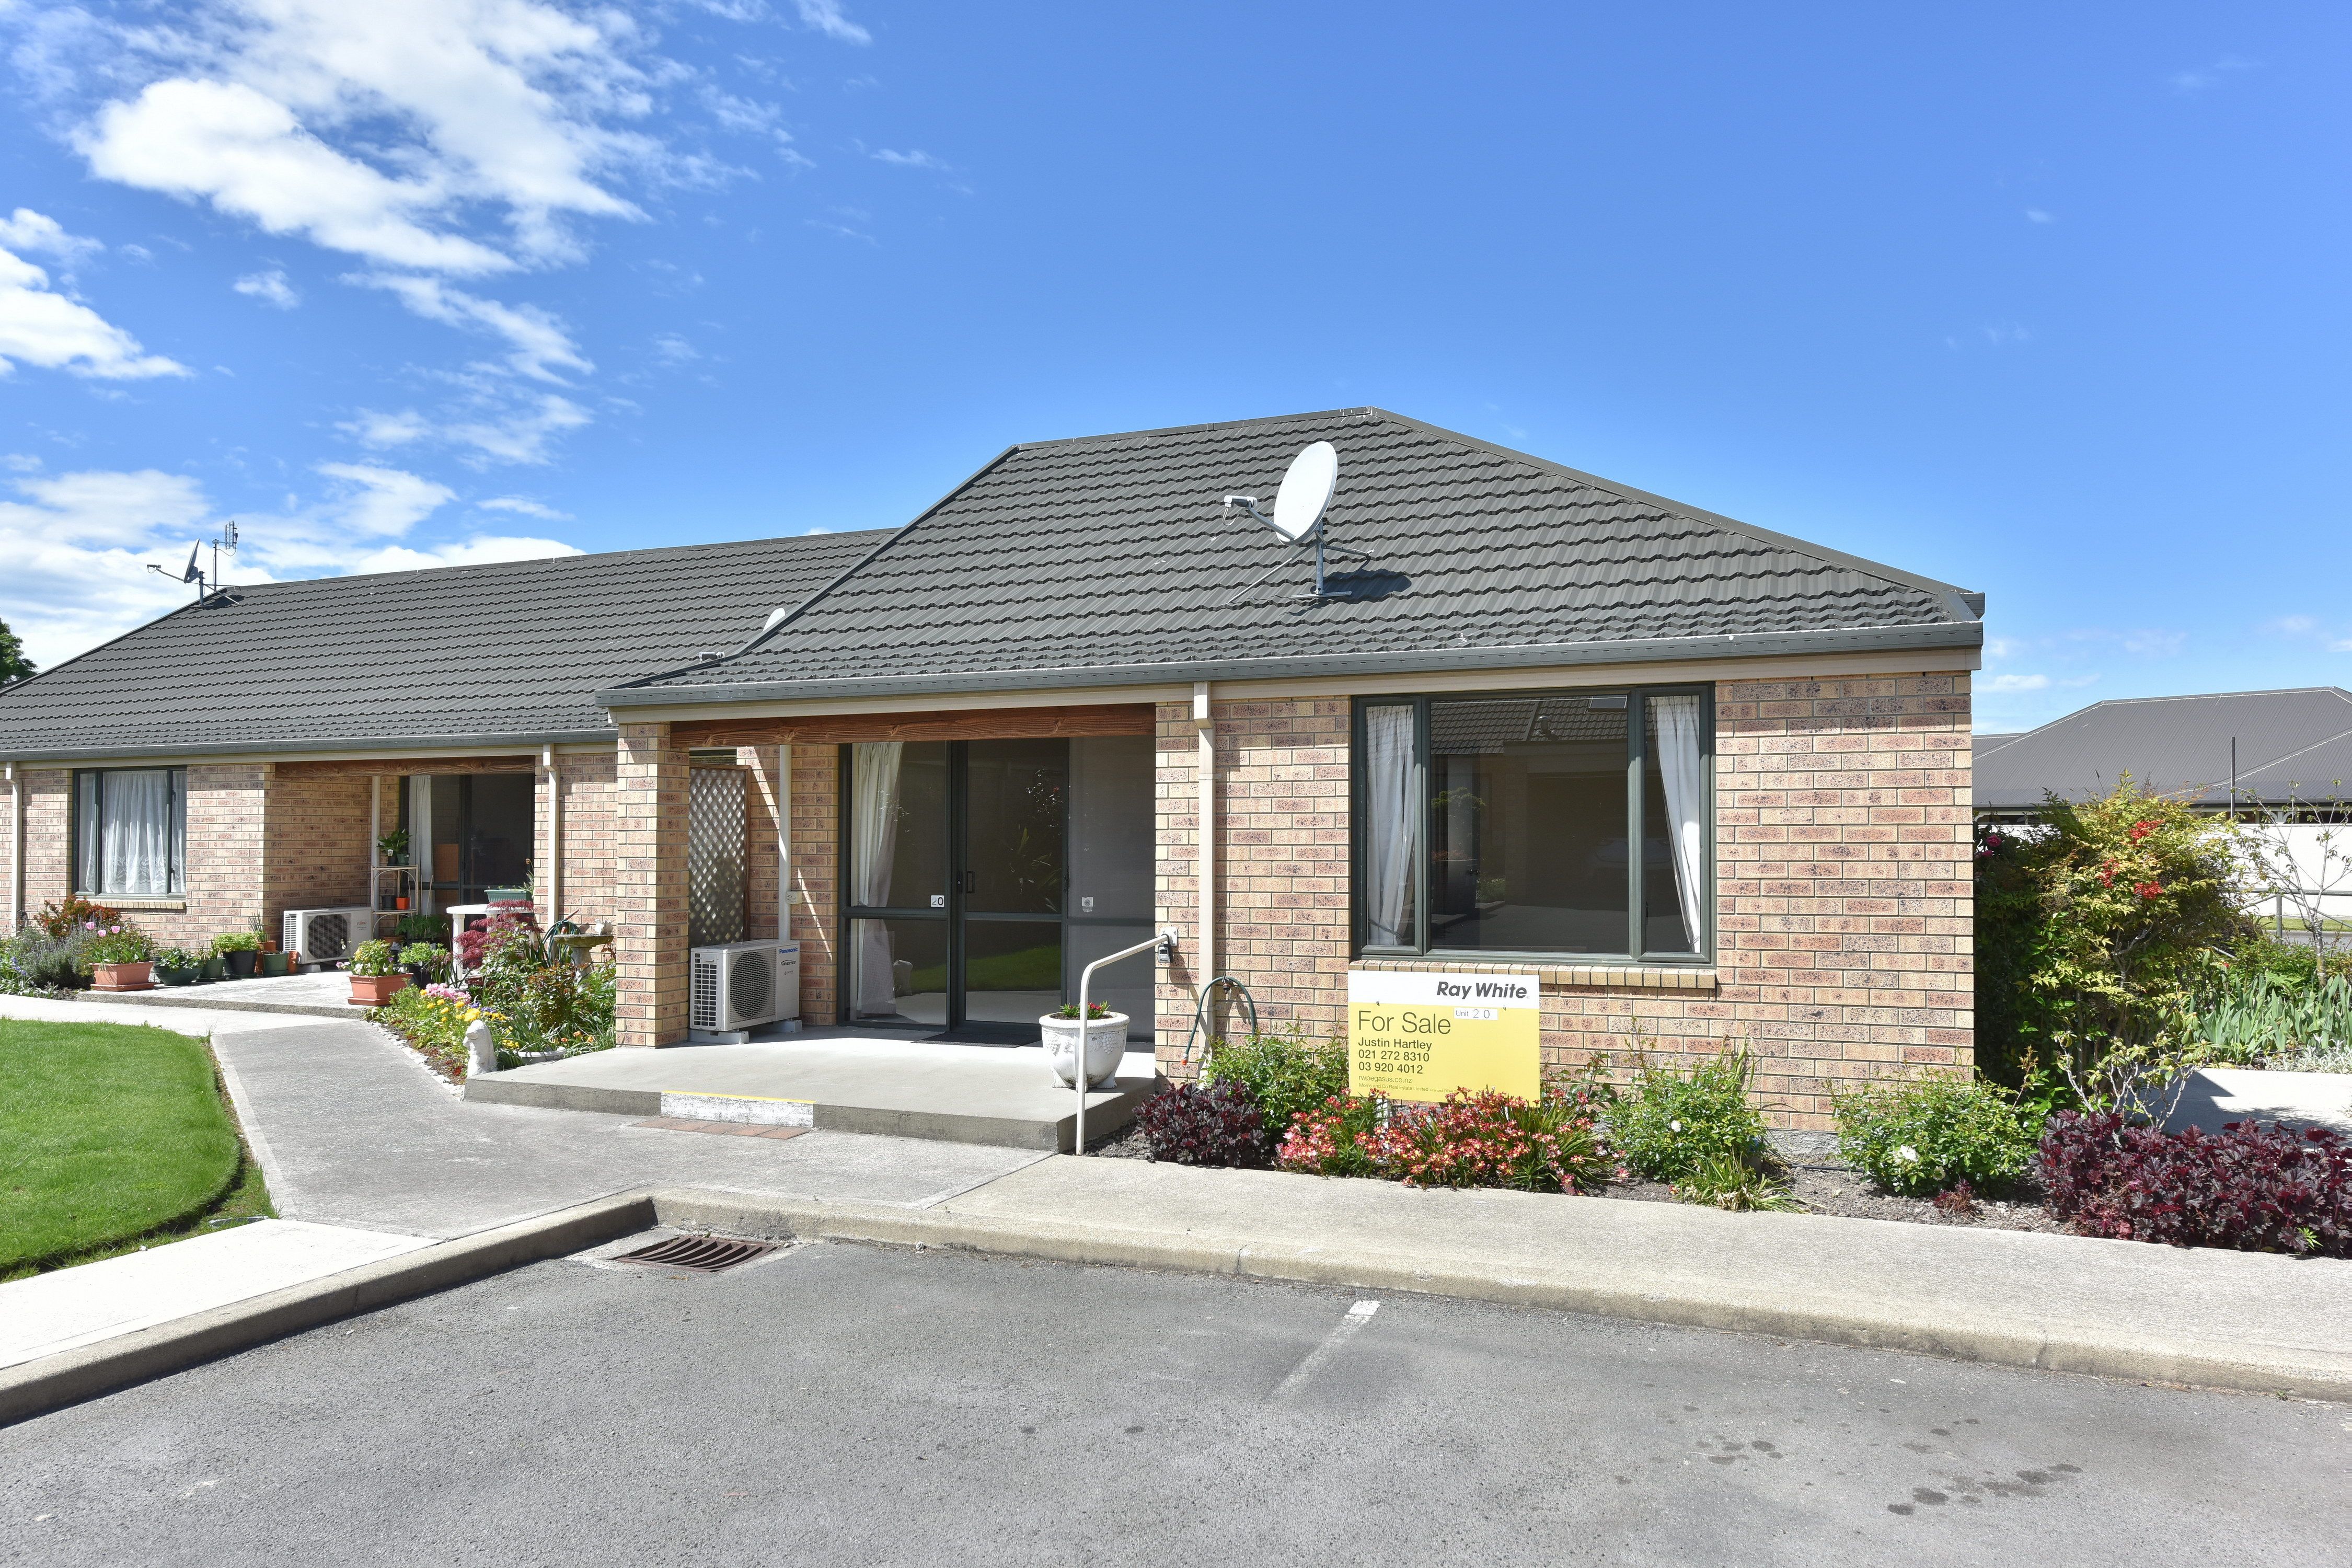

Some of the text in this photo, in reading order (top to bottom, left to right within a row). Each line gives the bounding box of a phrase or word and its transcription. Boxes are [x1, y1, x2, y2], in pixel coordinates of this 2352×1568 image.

[1437, 981, 1527, 999] Ray White
[1359, 1010, 1451, 1034] For Sale
[1358, 1037, 1432, 1052] Justin Hartley
[1358, 1049, 1429, 1062] 021 272 8310
[1359, 1062, 1423, 1074] 03 920 4012
[1359, 1075, 1412, 1083] rwpegasus.co.nz
